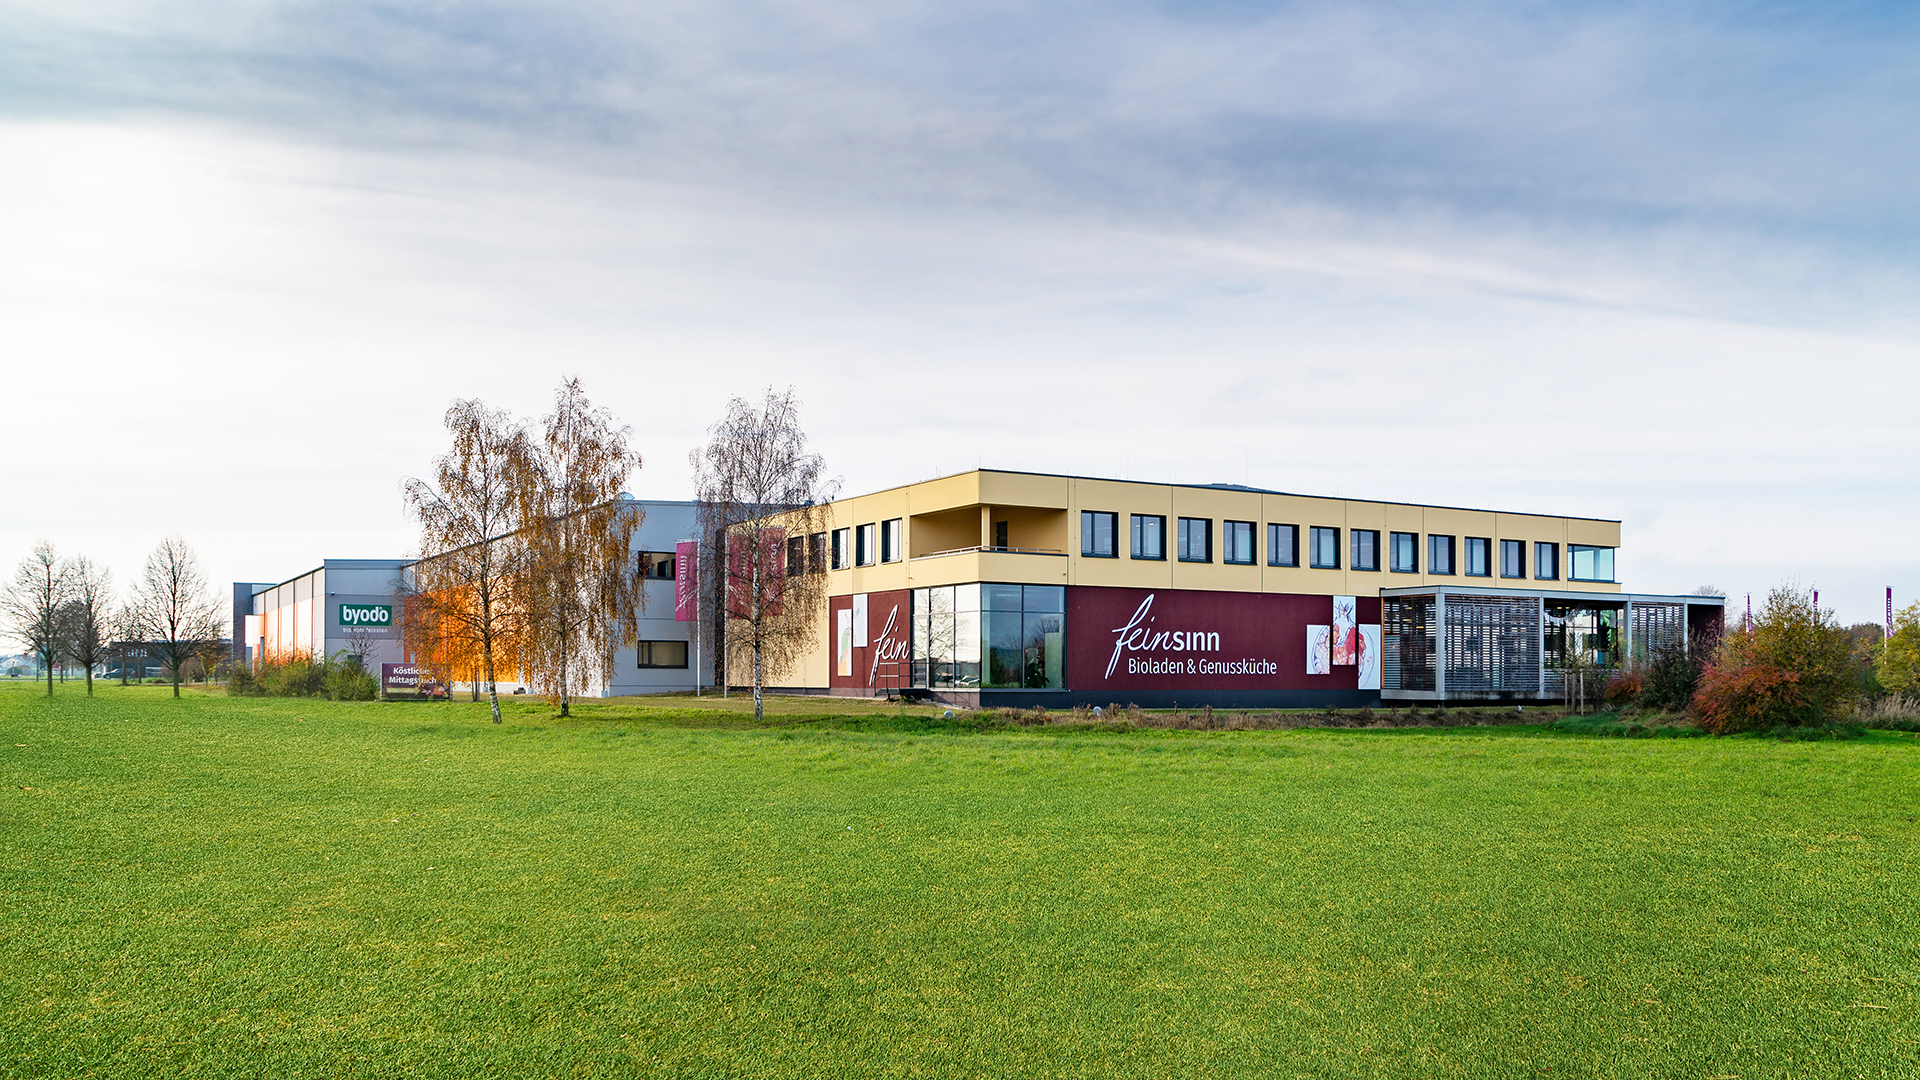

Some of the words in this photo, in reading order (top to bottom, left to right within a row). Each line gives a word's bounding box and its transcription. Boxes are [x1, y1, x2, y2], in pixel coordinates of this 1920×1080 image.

[343, 605, 389, 625] byodo
[1105, 593, 1220, 680] feinsinn
[869, 604, 910, 686] fein
[1128, 656, 1184, 675] Bioladen
[1187, 659, 1196, 675] &
[1199, 657, 1277, 675] Genussküche
